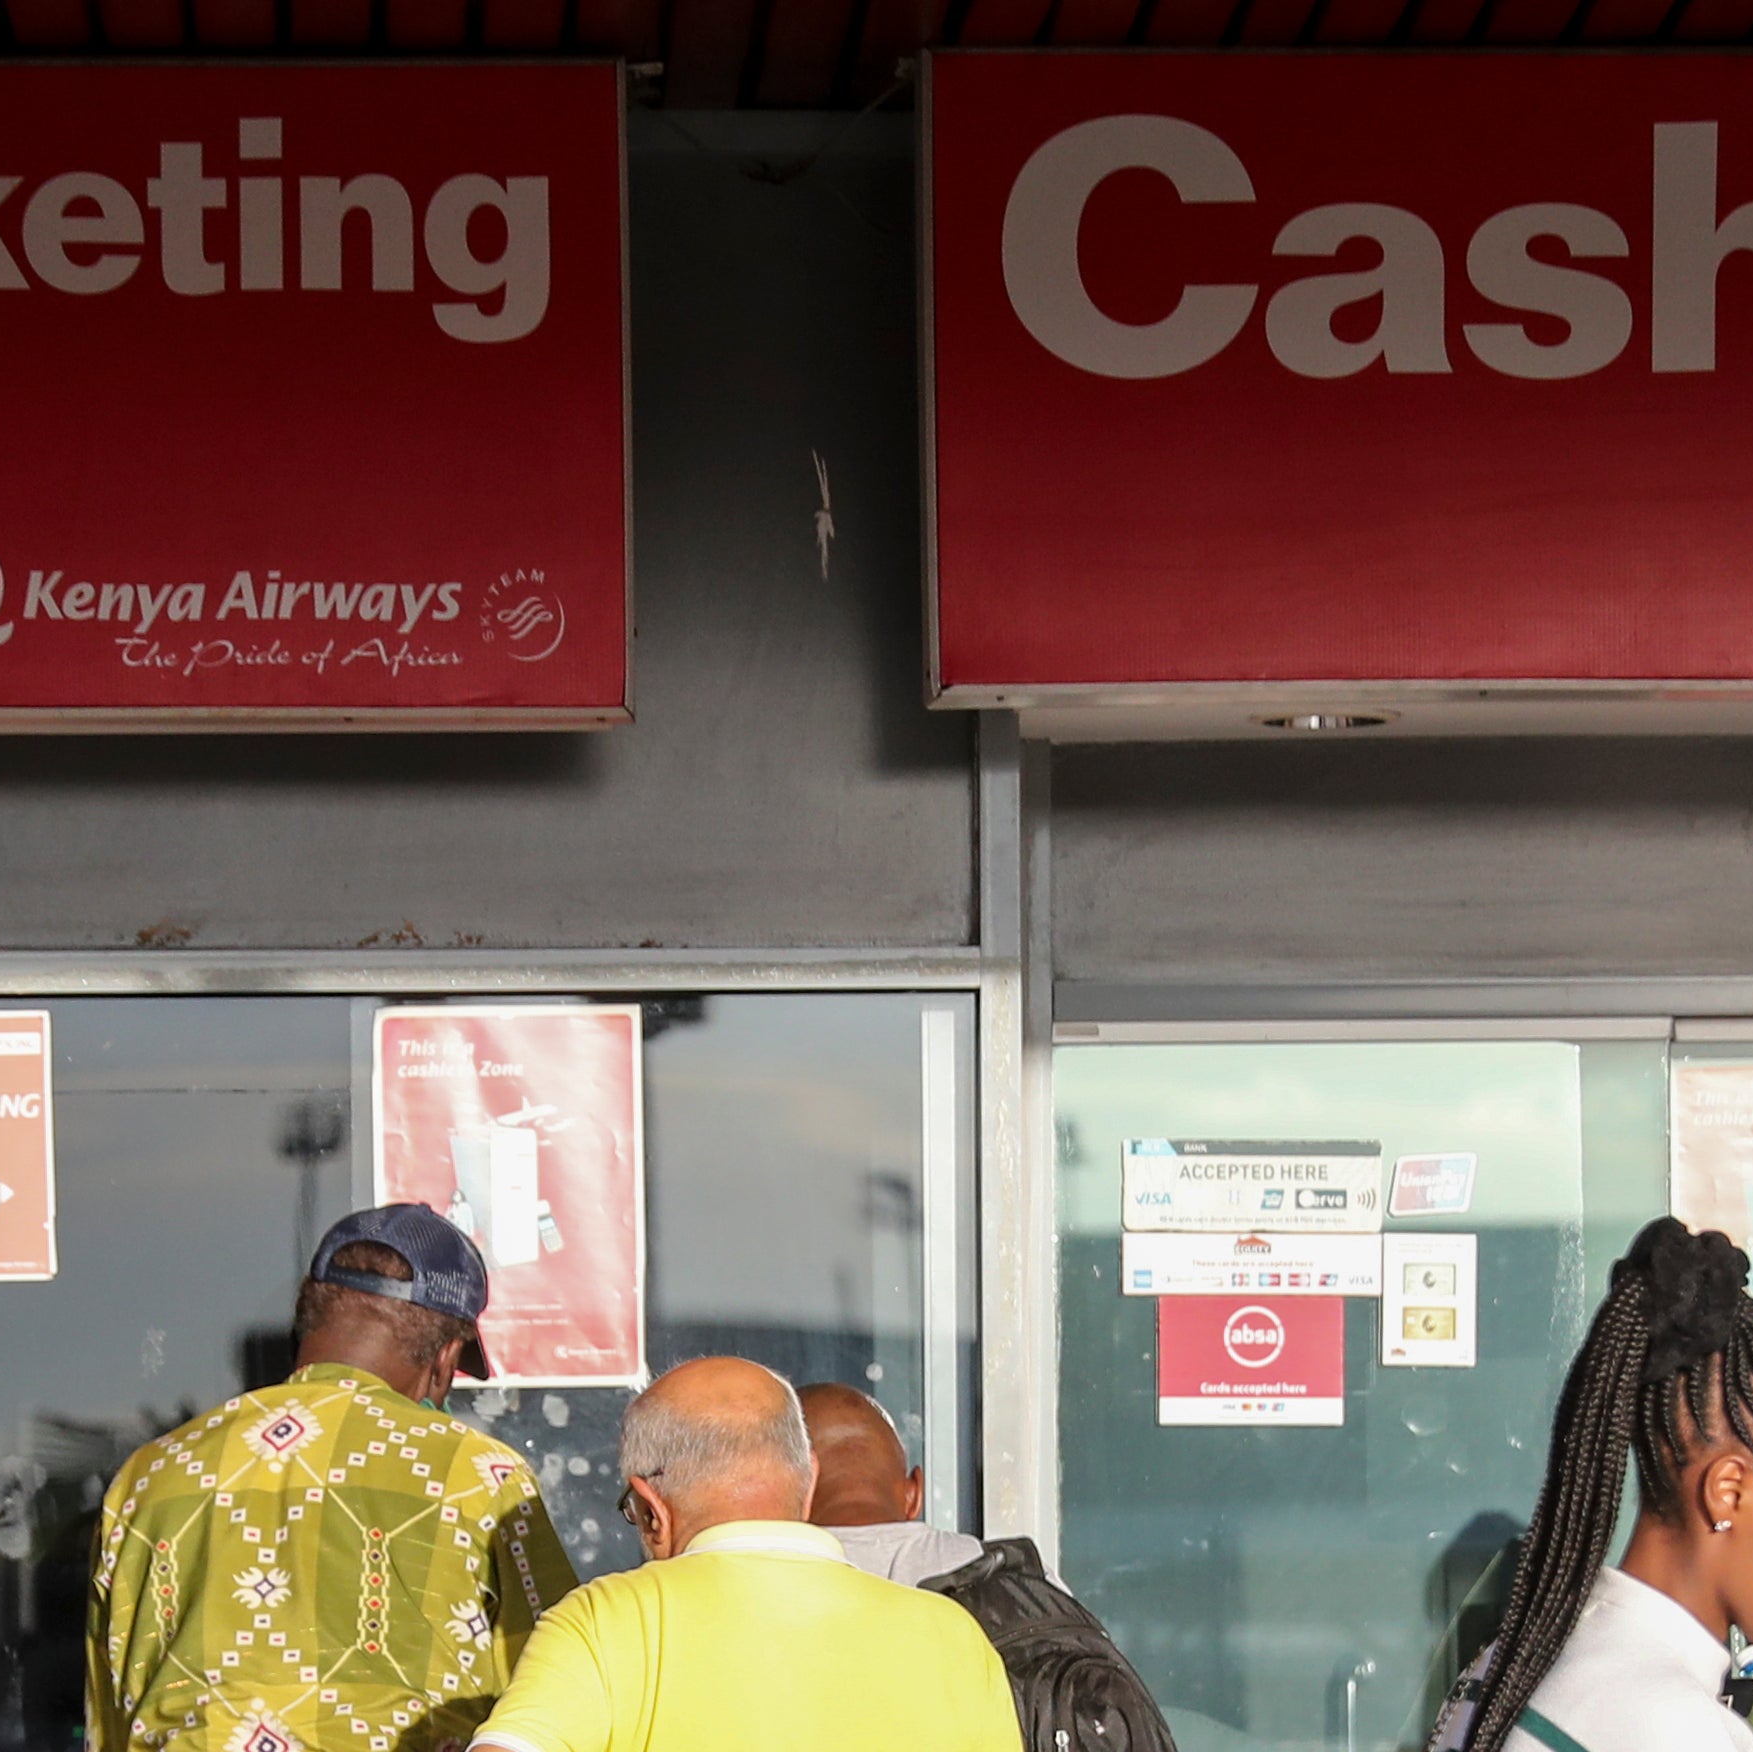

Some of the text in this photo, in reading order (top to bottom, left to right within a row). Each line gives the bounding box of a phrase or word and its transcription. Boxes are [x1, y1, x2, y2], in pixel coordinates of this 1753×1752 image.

[23, 570, 461, 634] Kenya Airways
[115, 637, 464, 677] The Pride of Africa
[398, 1039, 435, 1057] This
[479, 1061, 524, 1078] Zone
[1179, 1164, 1328, 1181] ACCEPTED HERE
[1135, 1192, 1172, 1205] VISA
[1348, 1275, 1373, 1286] VISA
[1230, 1325, 1277, 1345] absa
[1200, 1382, 1307, 1397] Cards accepted here
